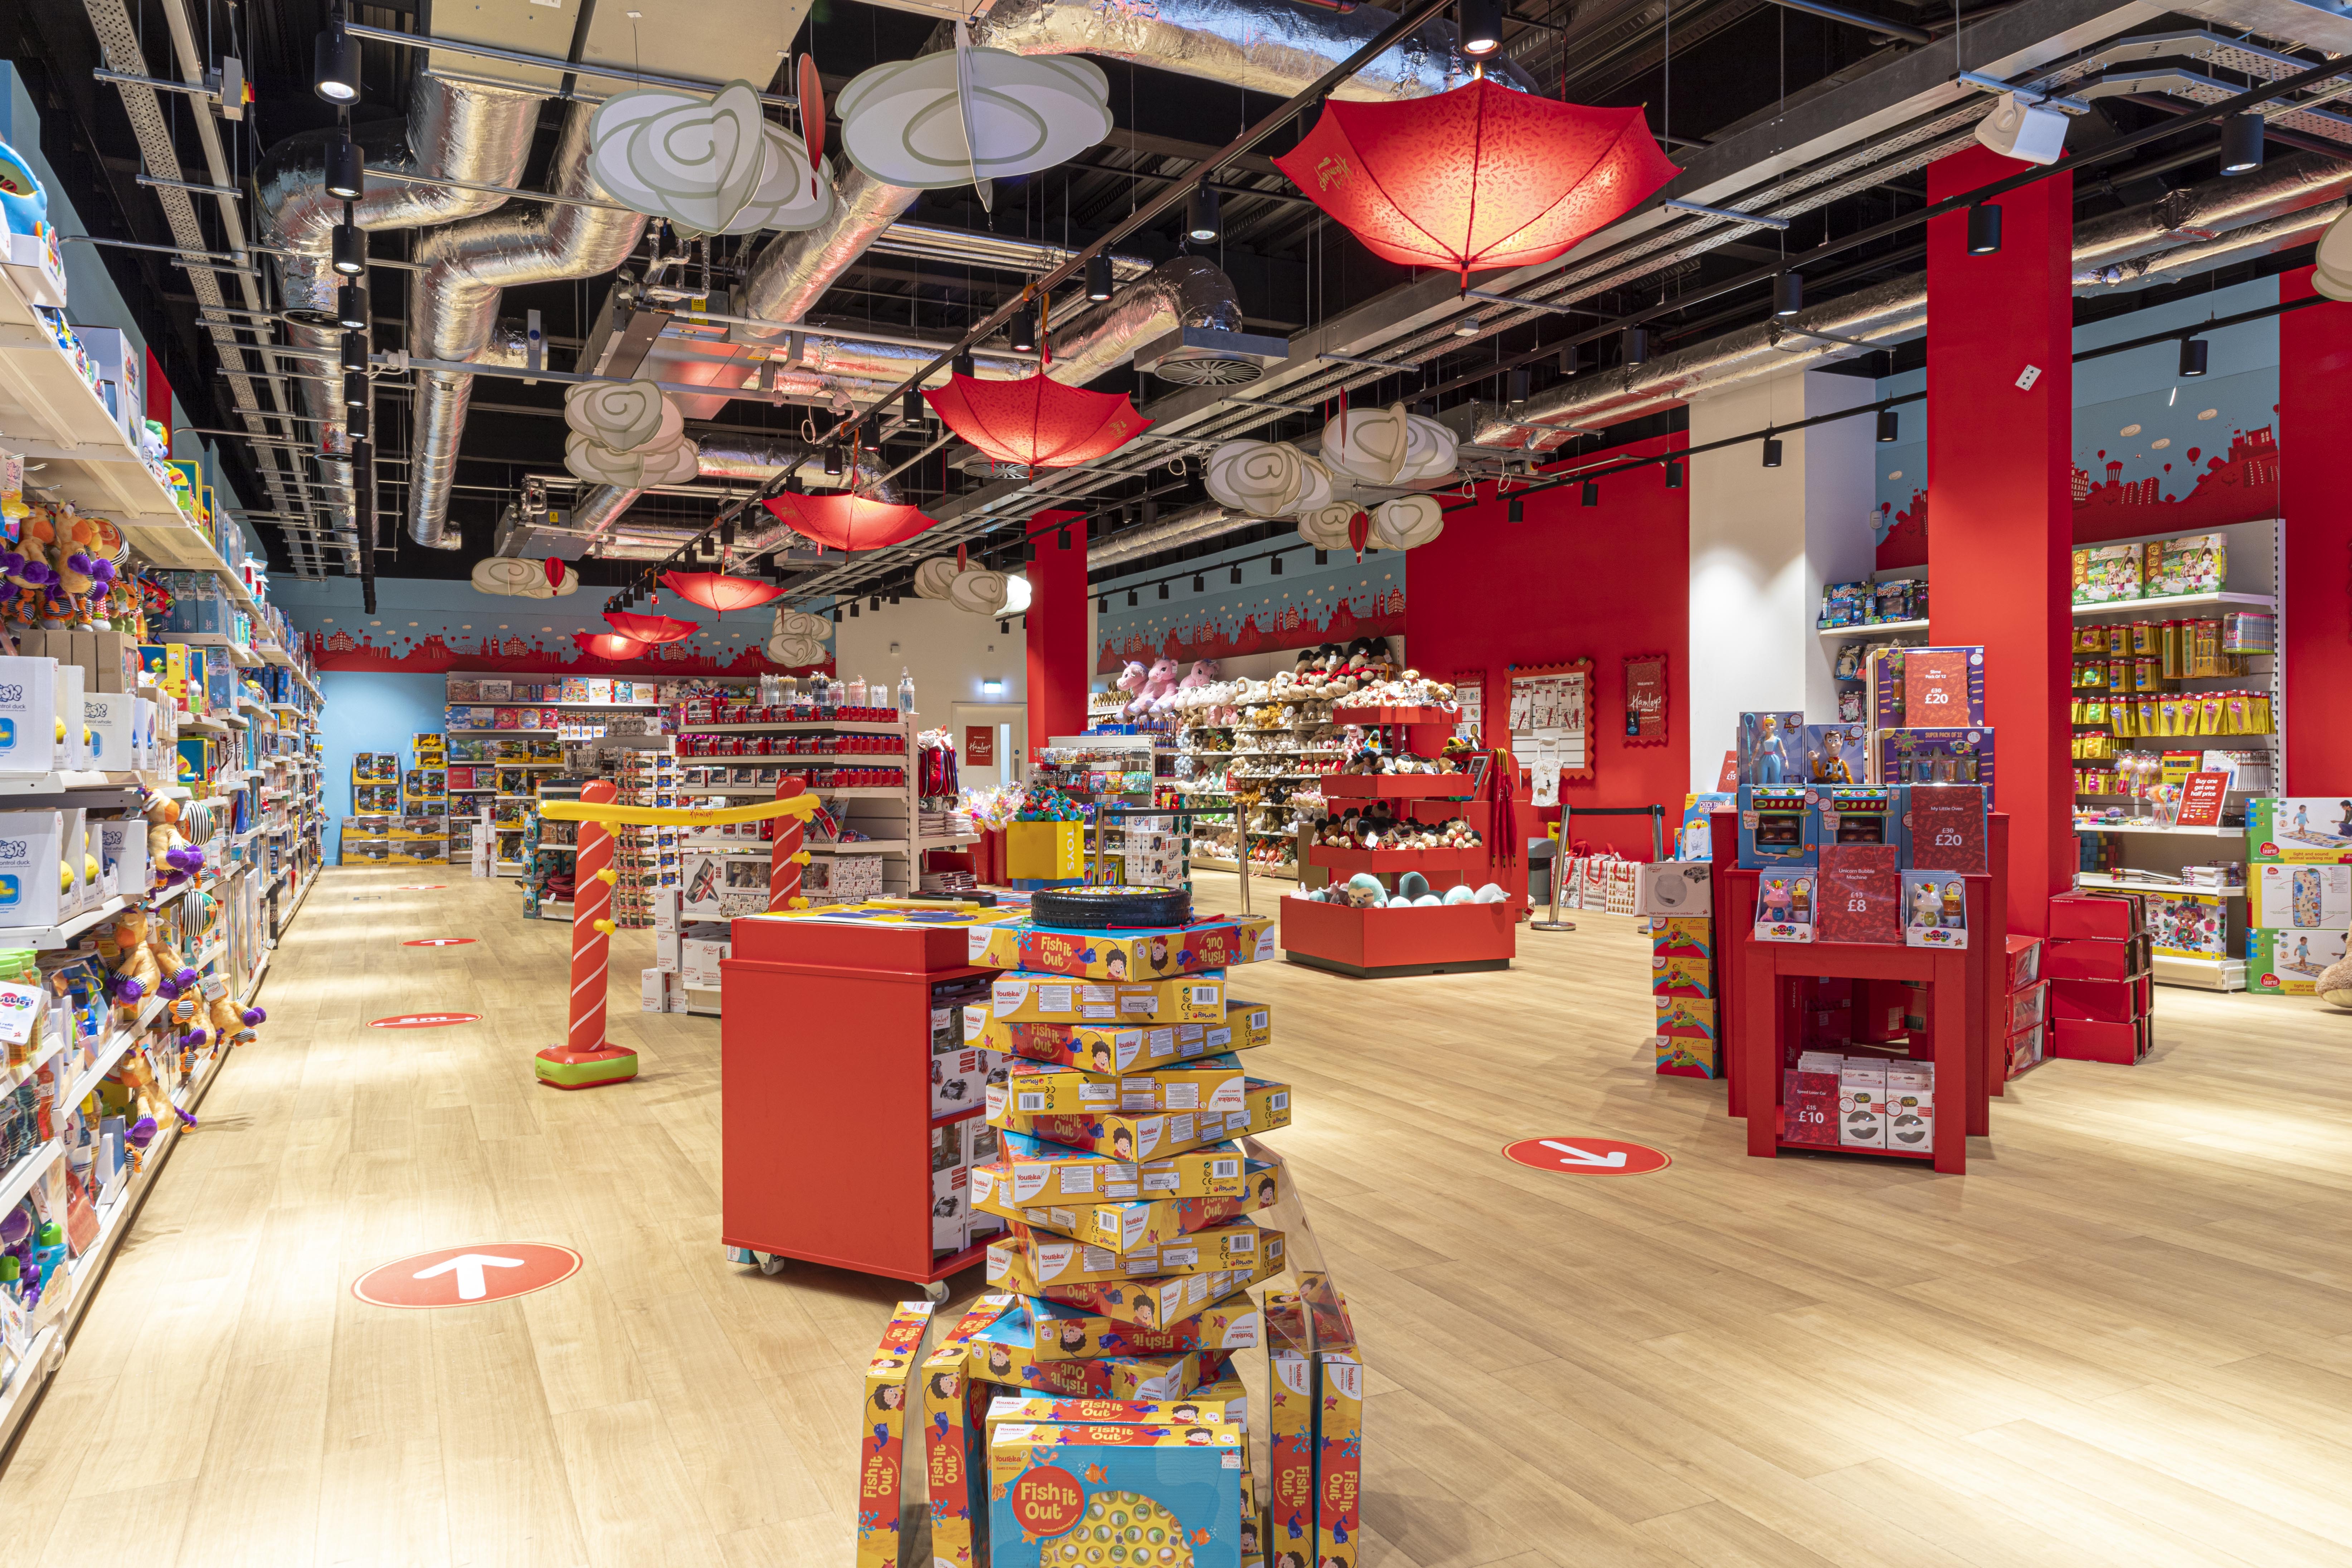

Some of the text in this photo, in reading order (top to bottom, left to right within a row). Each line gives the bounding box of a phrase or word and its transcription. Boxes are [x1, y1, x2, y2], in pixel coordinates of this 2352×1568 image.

[1833, 588, 1857, 599] Dragons
[1877, 585, 1902, 597] Dragons
[1630, 690, 1661, 712] Hamleys
[1925, 694, 1948, 704] £20
[968, 740, 991, 753] Hamleys
[1935, 834, 1962, 847] £20
[1847, 900, 1866, 912] £8
[1041, 936, 1072, 957] Fish it
[1207, 936, 1223, 949] Out
[1043, 951, 1064, 966] Out
[1033, 1037, 1053, 1053] Out
[1799, 1111, 1823, 1124] £10
[1055, 1120, 1073, 1138] Out
[1125, 1217, 1143, 1226] Youreka
[988, 1254, 1005, 1264] Youreka
[1067, 1285, 1088, 1302] Out
[1082, 1408, 1111, 1417] Out
[930, 1457, 944, 1487] Fish
[944, 1455, 958, 1483] Out
[863, 1469, 878, 1498] Fish
[878, 1466, 893, 1496] Out
[1282, 1469, 1295, 1496] Out
[1296, 1466, 1310, 1495] Fish
[1329, 1474, 1343, 1501] Out
[1344, 1471, 1357, 1500] Fish
[1021, 1482, 1077, 1506] Fish it
[1025, 1502, 1062, 1520] Out
[1058, 1522, 1071, 1531] fishing
